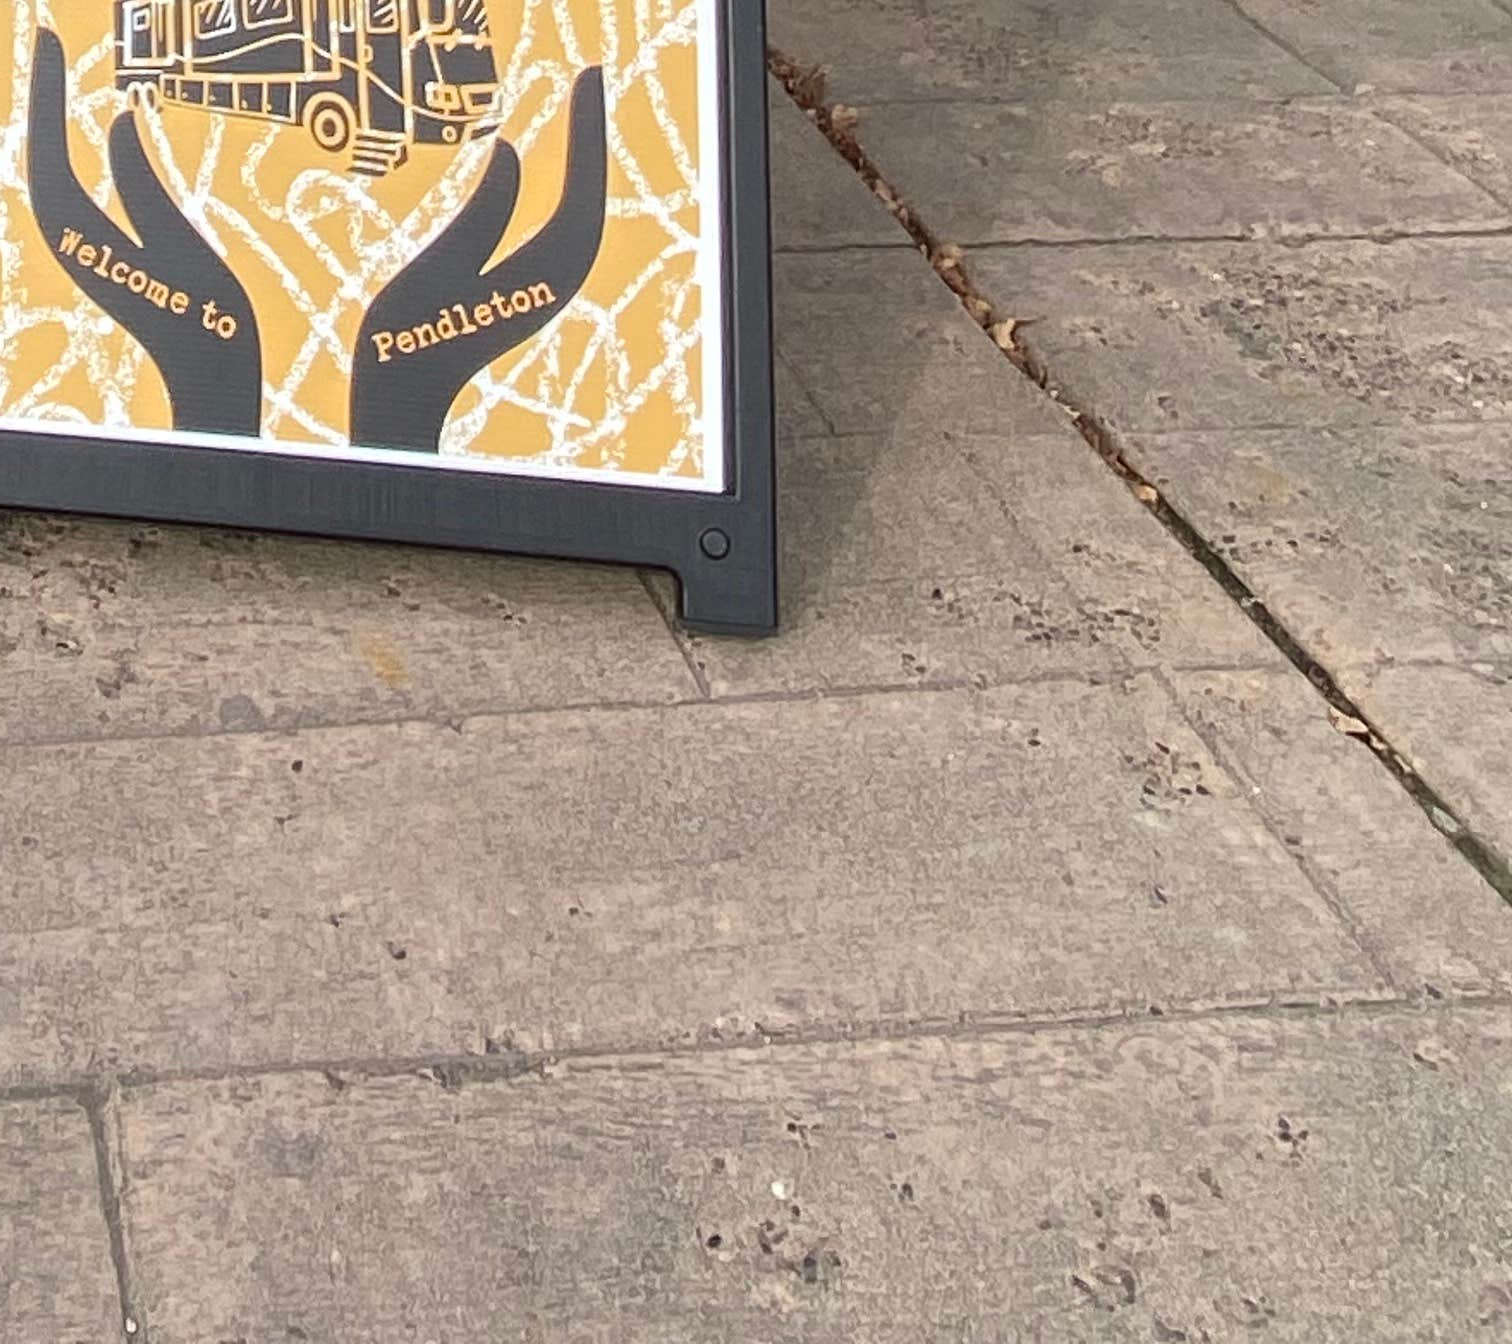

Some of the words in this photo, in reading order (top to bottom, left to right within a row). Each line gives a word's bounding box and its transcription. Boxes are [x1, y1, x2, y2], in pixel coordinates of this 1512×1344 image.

[57, 225, 190, 315] Welcome
[201, 298, 238, 341] to
[370, 276, 557, 364] Pendleton
